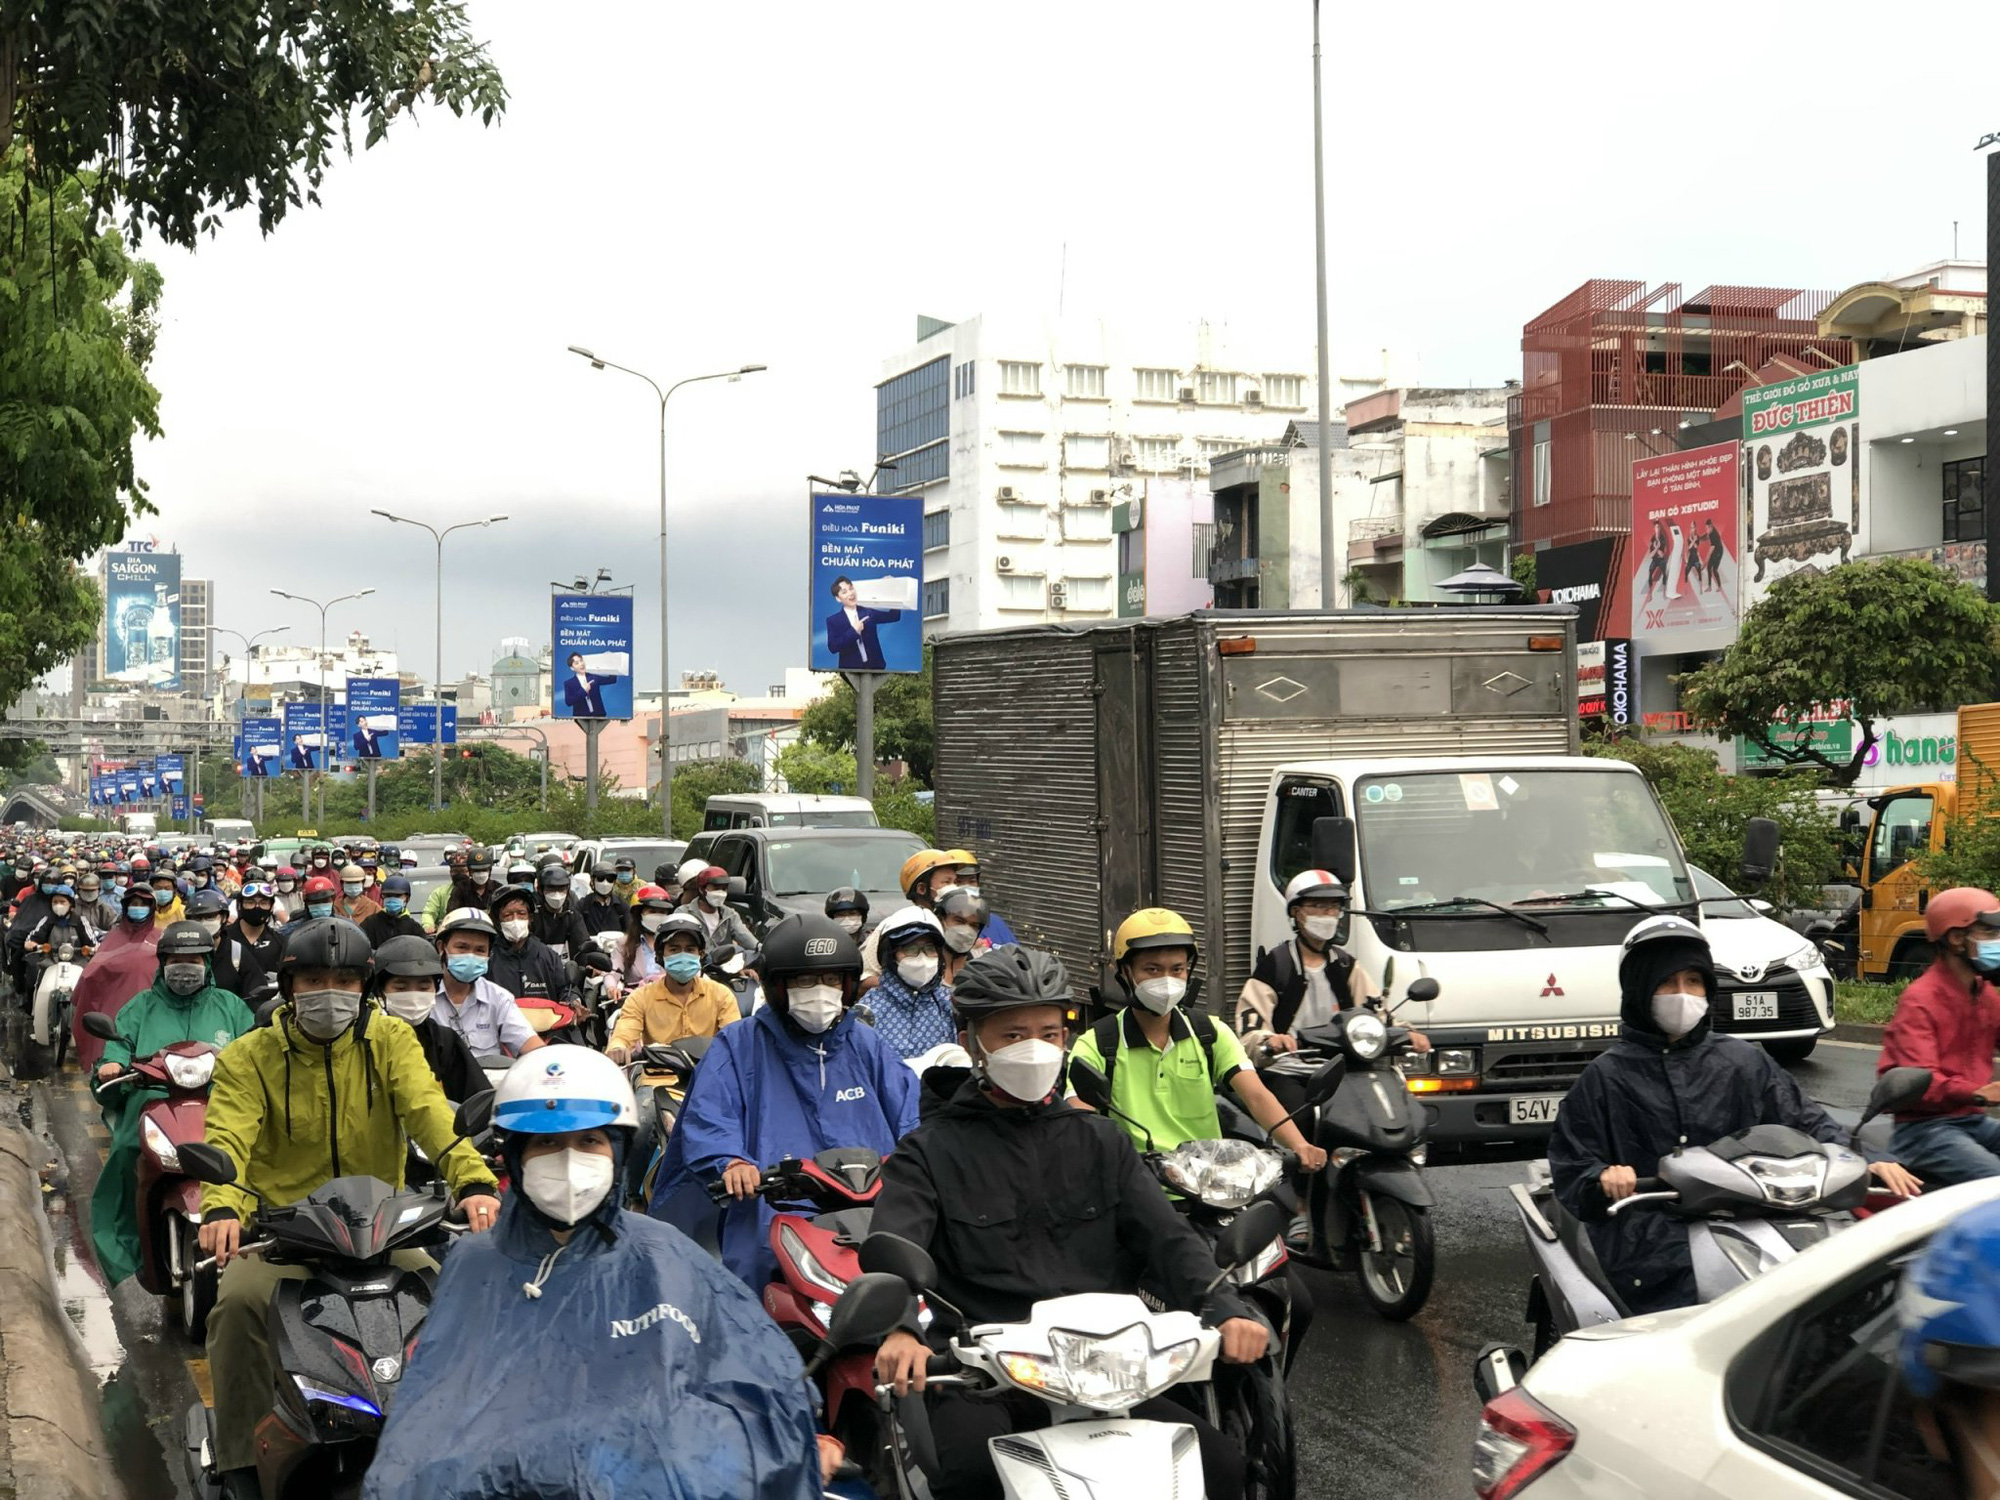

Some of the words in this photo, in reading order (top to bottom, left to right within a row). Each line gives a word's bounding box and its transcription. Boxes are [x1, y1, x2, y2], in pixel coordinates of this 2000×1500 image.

[1833, 374, 1839, 384] &
[1841, 370, 1860, 382] NAY
[1752, 401, 1794, 434] ĐỨC
[1796, 389, 1855, 424] THIỆN
[1649, 508, 1666, 520] BẠN
[1667, 504, 1679, 516] CÓ
[822, 523, 840, 532] ĐIỀU
[842, 524, 859, 532] HÒA
[861, 522, 905, 534] Funiki
[128, 541, 153, 552] TTC
[821, 542, 841, 553] BỀN
[844, 544, 864, 554] MÁT
[821, 554, 860, 567] CHUẨN
[862, 556, 885, 568] HÒA
[888, 557, 915, 569] PHÁT
[1551, 582, 1601, 605] YOKOHAMA
[588, 613, 620, 622] Funiki
[560, 627, 574, 636] BỀN
[576, 629, 591, 637] MÁT
[560, 636, 588, 646] CHUẨN
[589, 638, 606, 646] HÒA
[607, 638, 627, 647] PHÁT
[1613, 642, 1628, 725] OKOHAMA
[1291, 786, 1318, 797] CANTER
[806, 938, 837, 956] EGO
[1745, 995, 1765, 1005] 61A
[1738, 1006, 1773, 1018] 987.35
[1488, 1024, 1618, 1041] MITSUBISH
[836, 1086, 865, 1102] ACB
